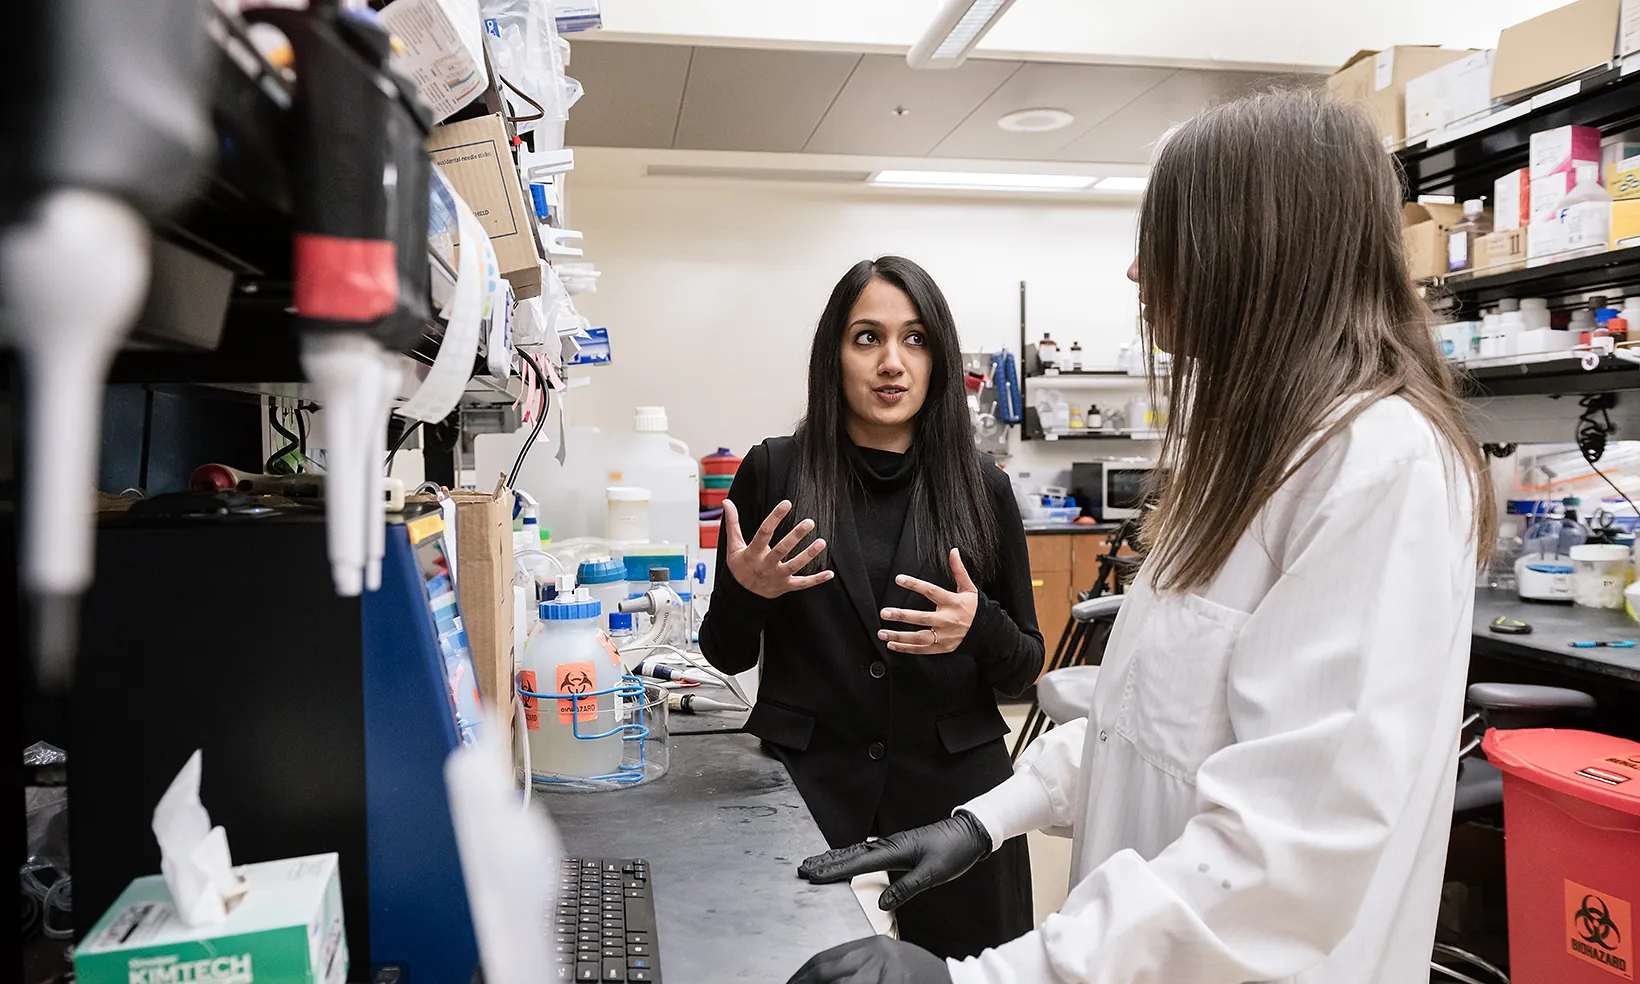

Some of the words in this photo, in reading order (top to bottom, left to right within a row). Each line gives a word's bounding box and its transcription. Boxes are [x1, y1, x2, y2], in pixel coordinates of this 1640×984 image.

[472, 209, 490, 217] HIELD
[560, 704, 596, 713] BIOZARD
[1571, 937, 1627, 973] BIOHAZARD
[128, 953, 252, 984] KIMTECH
